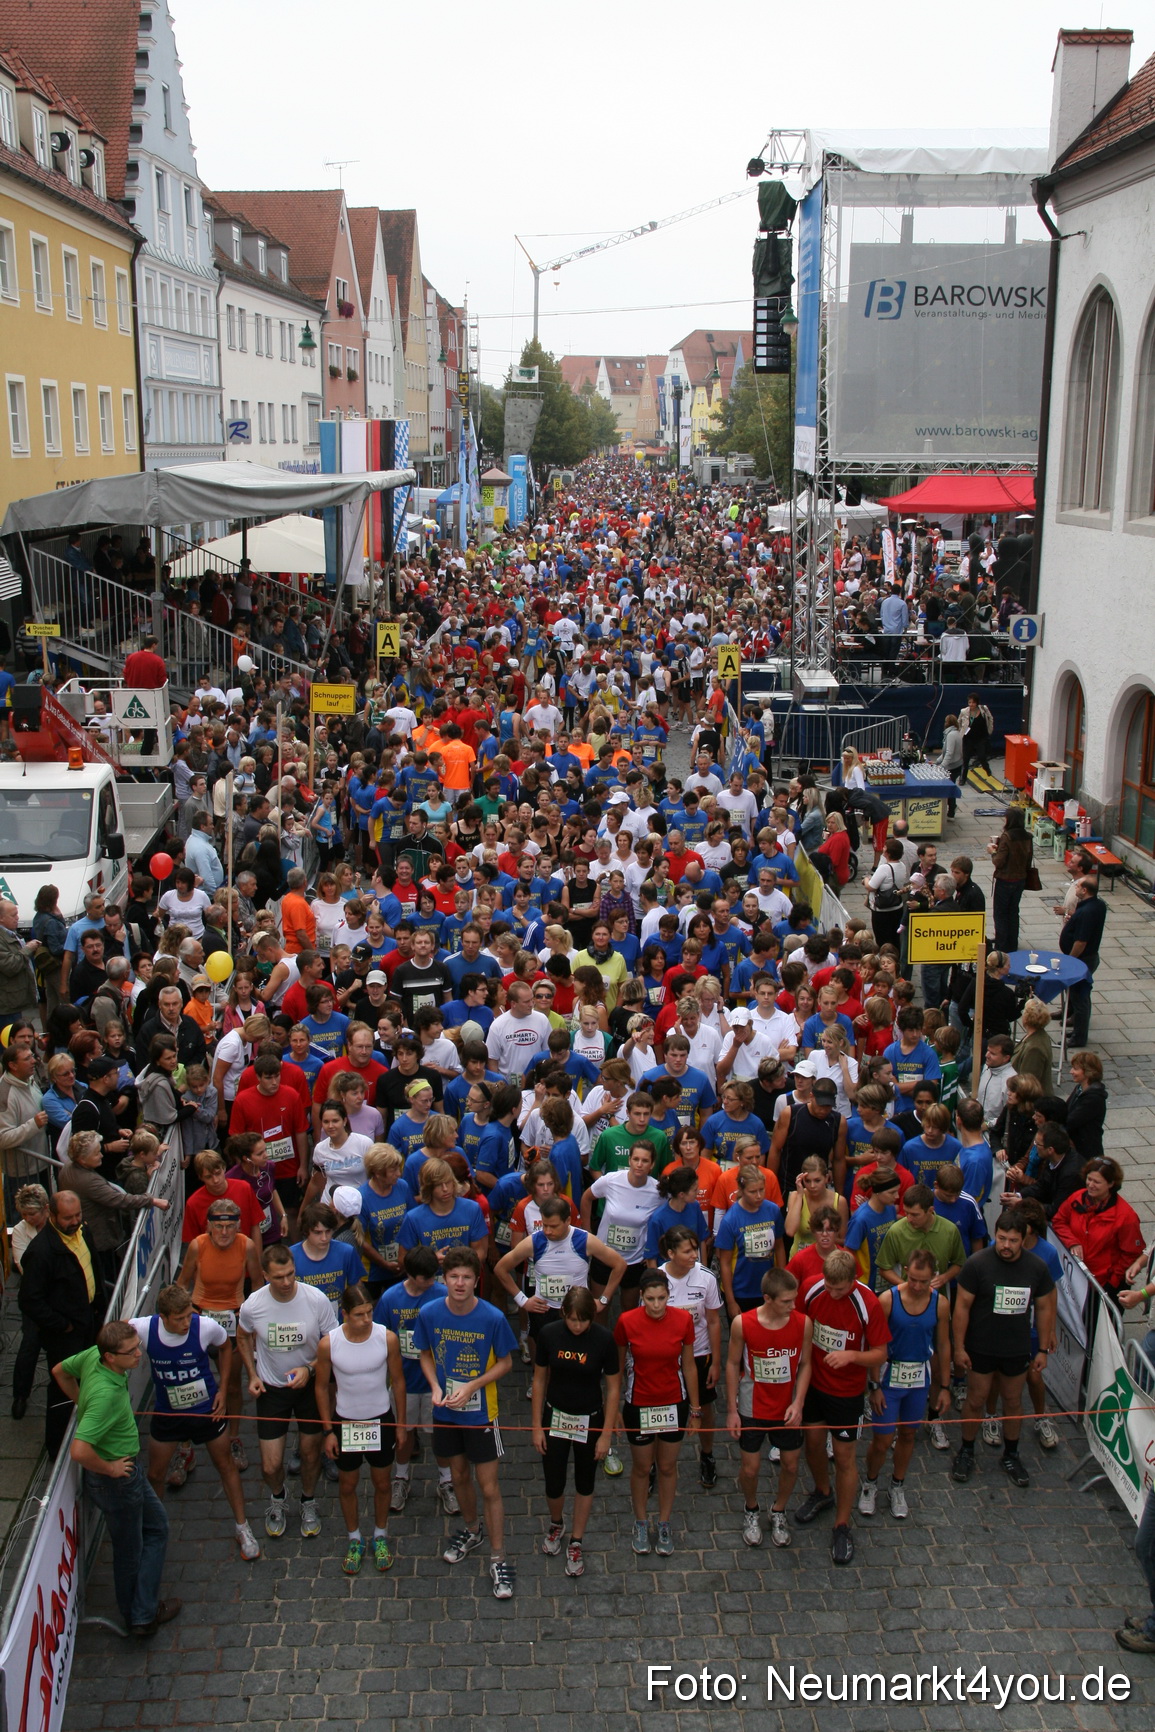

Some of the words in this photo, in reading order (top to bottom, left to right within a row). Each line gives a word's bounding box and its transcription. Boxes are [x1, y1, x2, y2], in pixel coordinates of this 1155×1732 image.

[914, 285, 1046, 308] BAROWSK
[914, 309, 992, 320] Veranstaltungs-
[995, 310, 1014, 319] und
[914, 424, 1038, 441] www.barowski-ag
[381, 633, 395, 649] A
[720, 645, 738, 653] Block
[723, 654, 736, 671] A
[314, 691, 352, 699] Schnupper-
[914, 928, 979, 939] Schnupper-
[936, 941, 957, 951] lauf
[274, 1145, 292, 1156] 5082
[616, 1235, 636, 1244] 5133
[754, 1239, 773, 1249] 5191
[549, 1285, 571, 1294] 5147
[1004, 1297, 1026, 1306] 5002
[279, 1333, 303, 1343] 5129
[441, 1334, 475, 1344] STADTLAUF
[442, 1328, 485, 1340] NEUMARKTER
[819, 1335, 843, 1348] 5170
[557, 1350, 584, 1360] ROXY
[764, 1366, 788, 1376] 5172
[901, 1370, 922, 1380] 5157
[180, 1390, 204, 1402] 5201
[650, 1413, 675, 1424] 5015
[353, 1431, 378, 1441] 5186
